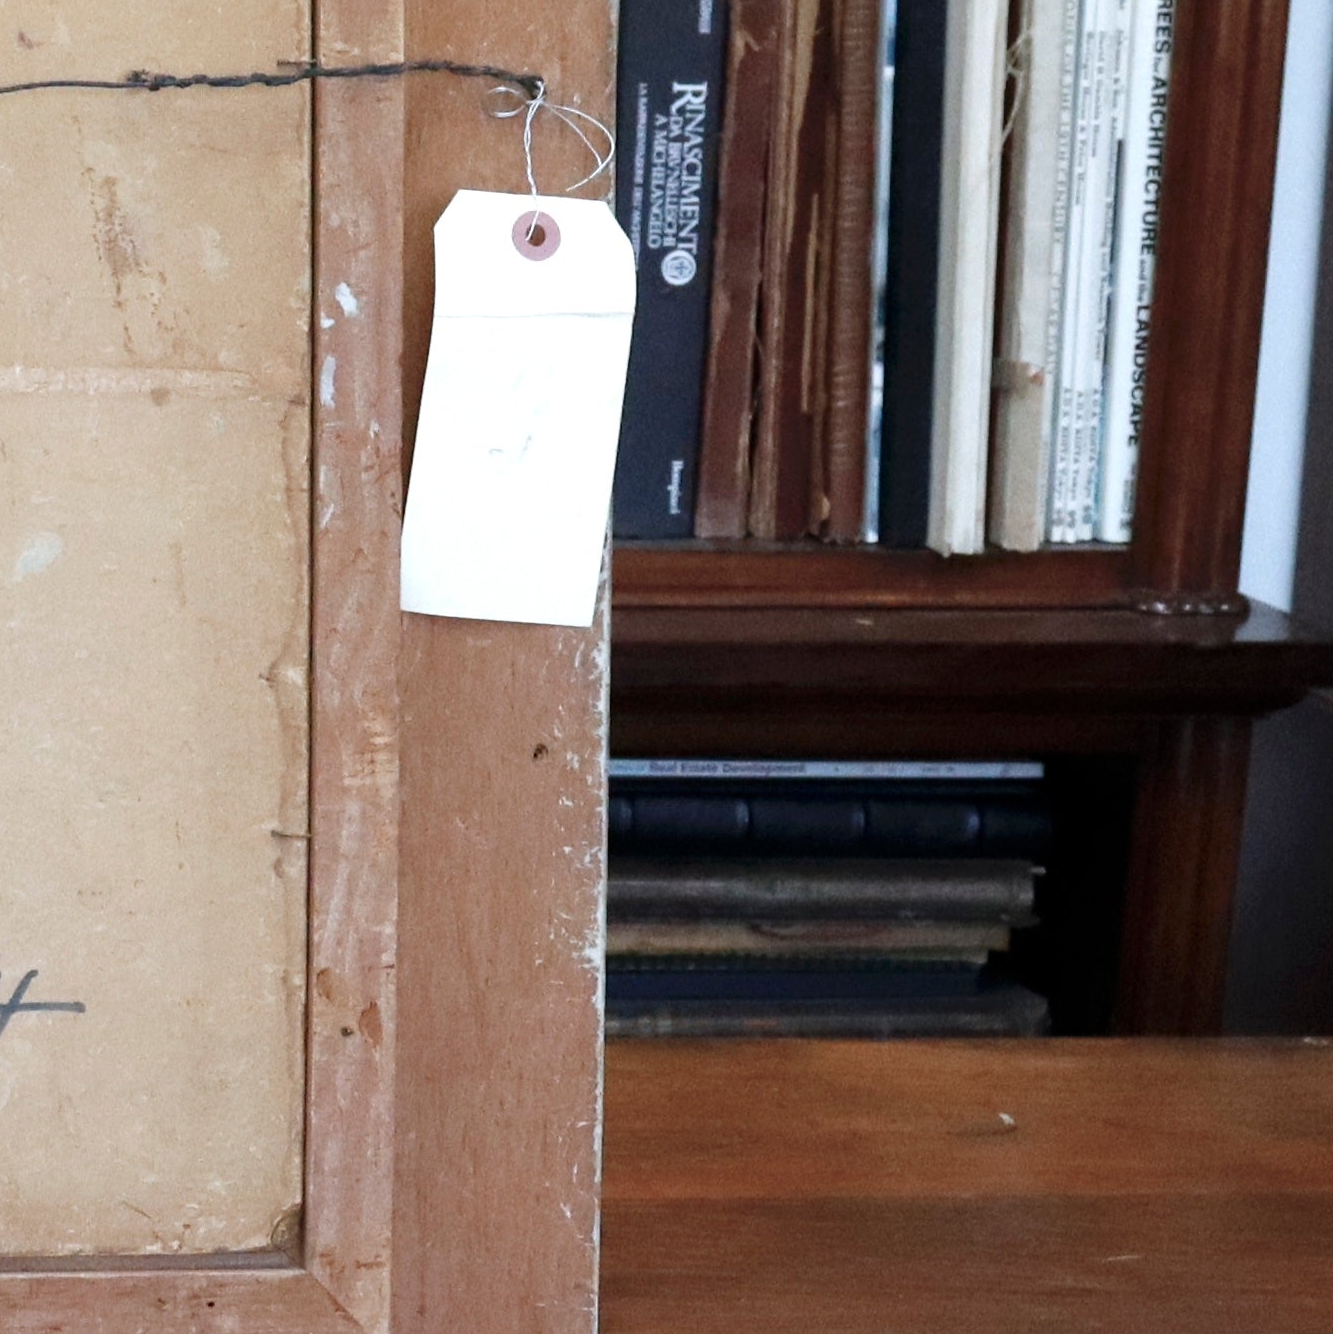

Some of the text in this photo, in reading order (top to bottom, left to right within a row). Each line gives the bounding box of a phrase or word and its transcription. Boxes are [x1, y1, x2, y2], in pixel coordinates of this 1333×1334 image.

[647, 113, 667, 250] A MICHELANGELO
[668, 115, 684, 138] DA
[1139, 75, 1172, 256] ARCHITECTURE
[1127, 304, 1152, 448] LANDSCAPE
